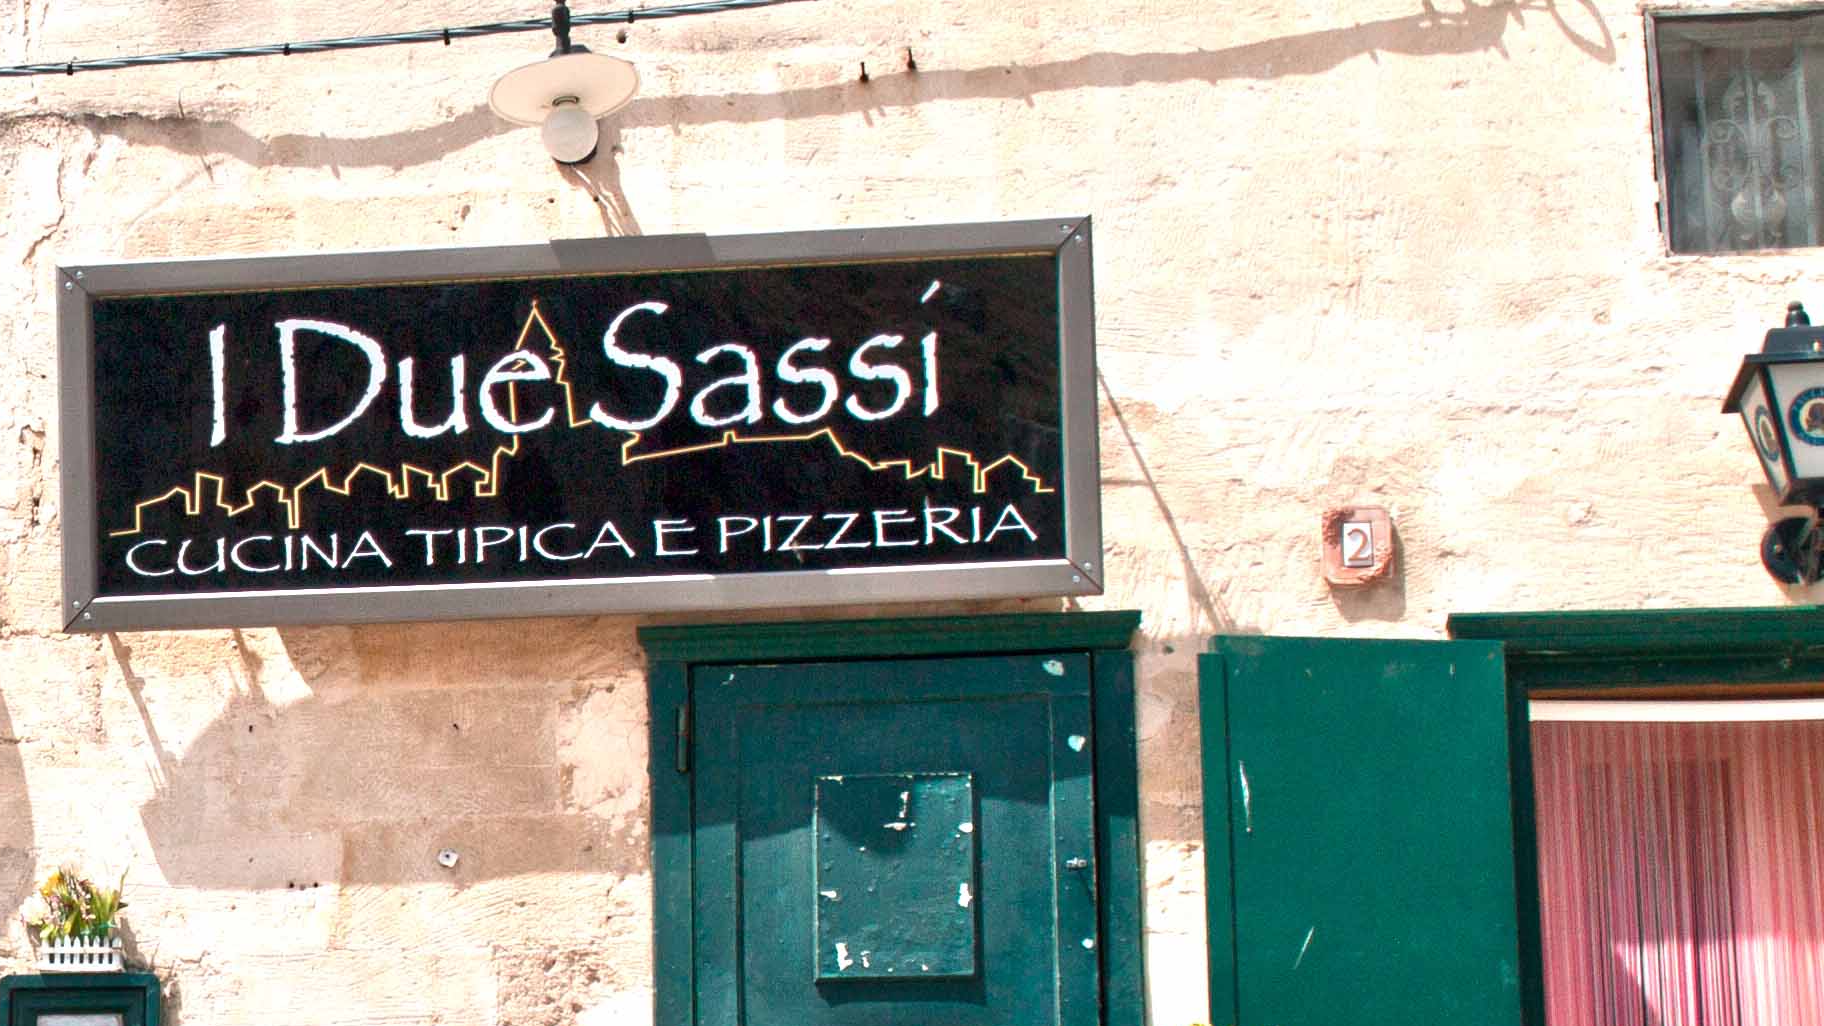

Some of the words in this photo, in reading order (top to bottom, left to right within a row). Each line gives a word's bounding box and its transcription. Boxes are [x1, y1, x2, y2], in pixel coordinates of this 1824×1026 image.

[209, 324, 226, 447] I
[274, 318, 556, 445] Due
[125, 530, 393, 578] CUCINA
[405, 520, 636, 567] TIPICA
[653, 519, 698, 556] E
[718, 503, 1039, 553] PIZZERIA
[1346, 527, 1372, 562] 2
